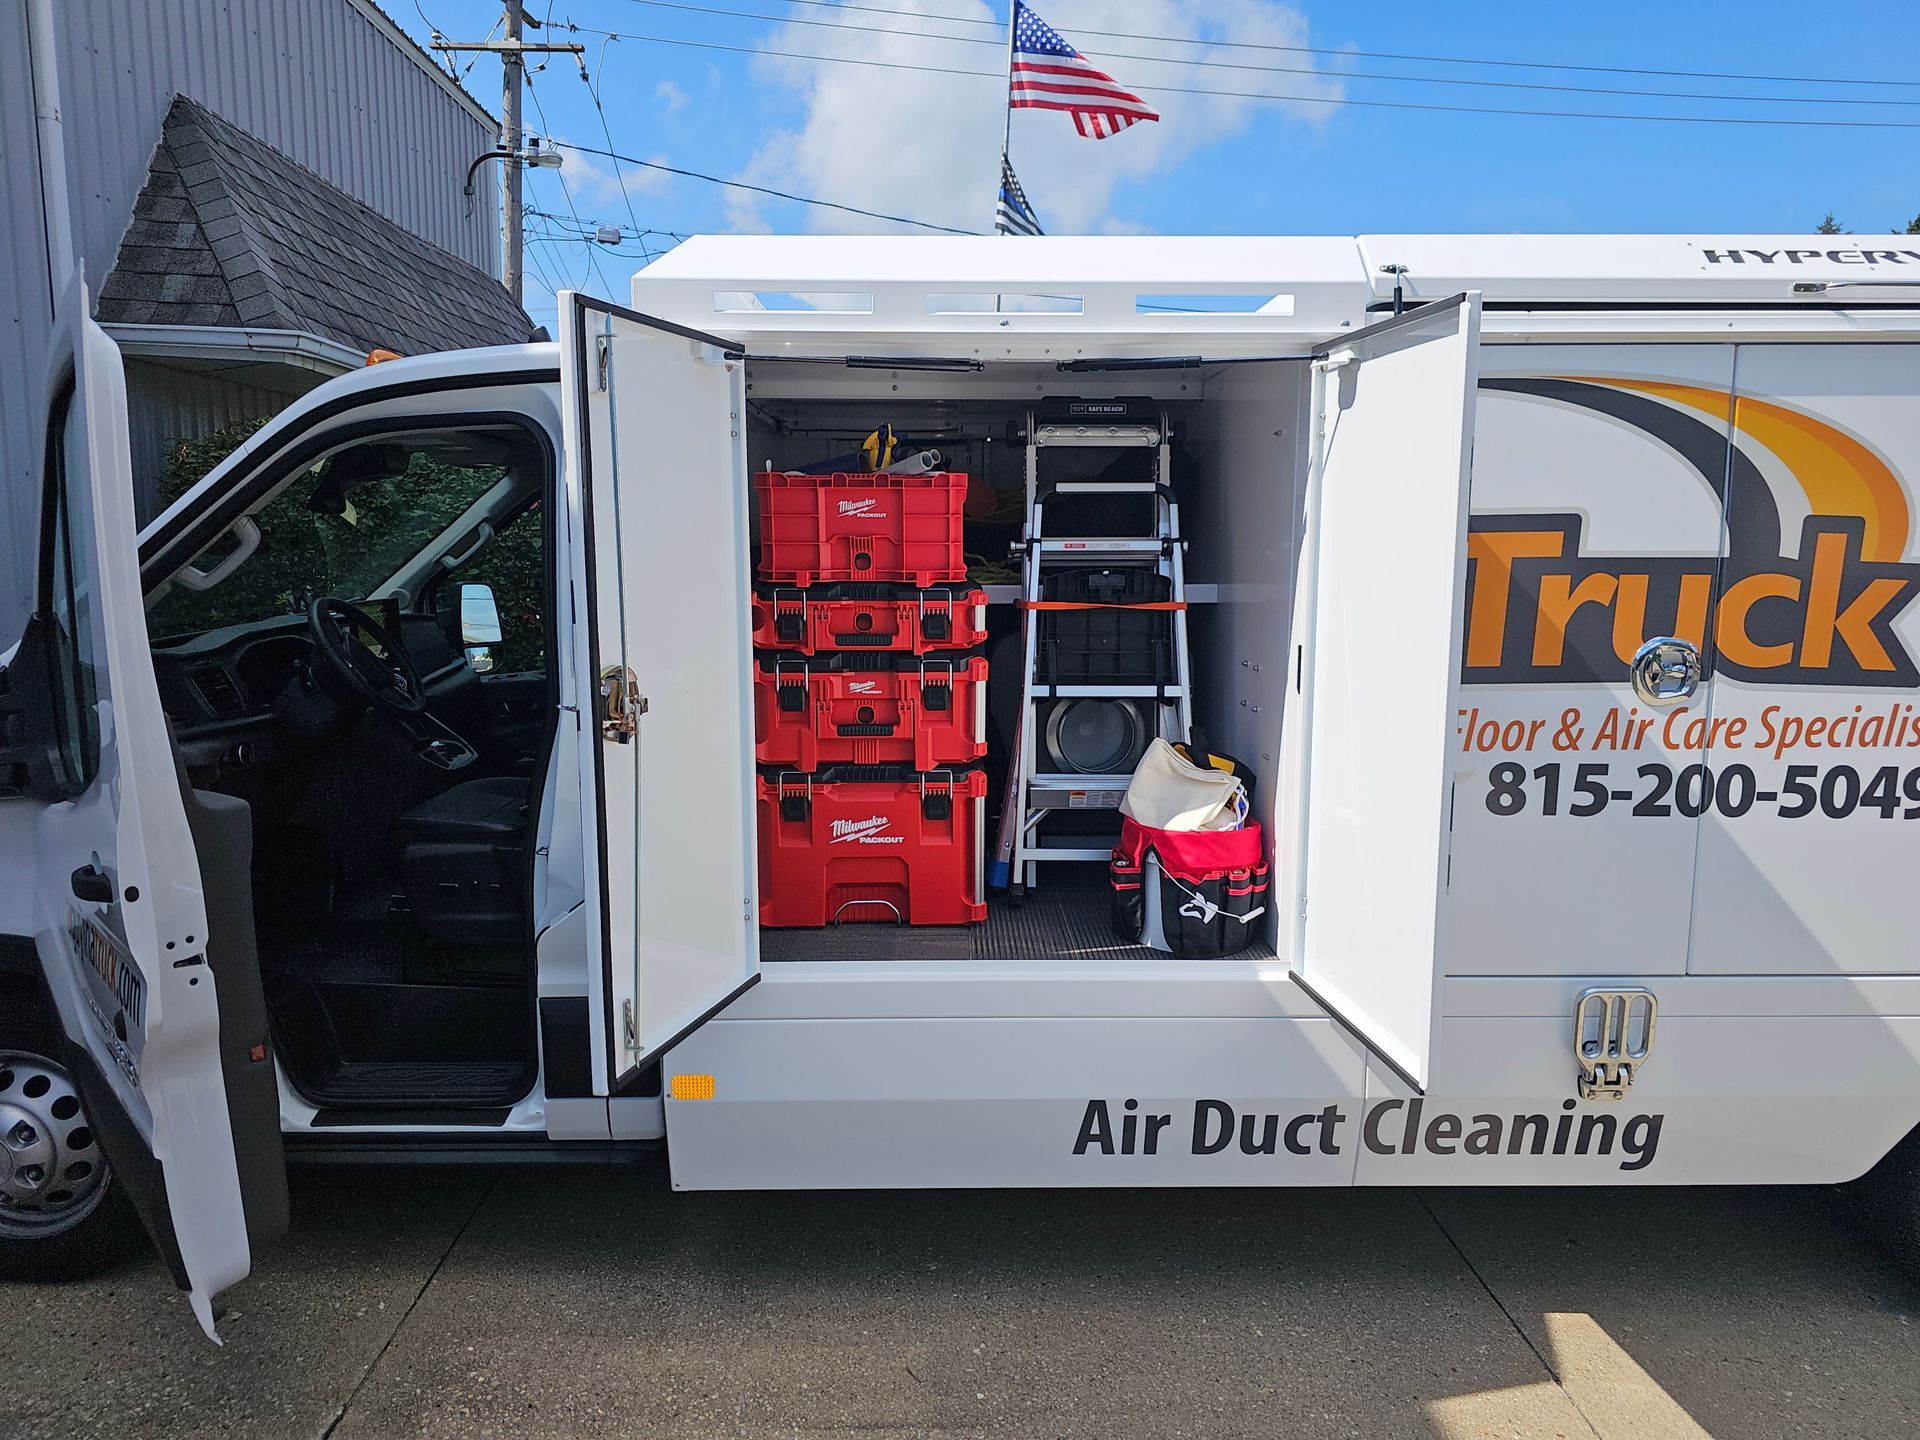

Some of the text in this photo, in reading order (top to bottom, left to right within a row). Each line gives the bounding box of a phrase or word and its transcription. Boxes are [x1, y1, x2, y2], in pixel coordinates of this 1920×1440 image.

[836, 497, 877, 514] Milwaukee
[1466, 530, 1910, 672] Truck
[1552, 707, 1585, 752] &
[1591, 707, 1654, 751] Air
[1662, 706, 1748, 751] Care
[829, 815, 889, 838] Milwaukee
[859, 836, 905, 844] PACKOUT
[1072, 1097, 1665, 1171] Air Duct Cleaning
